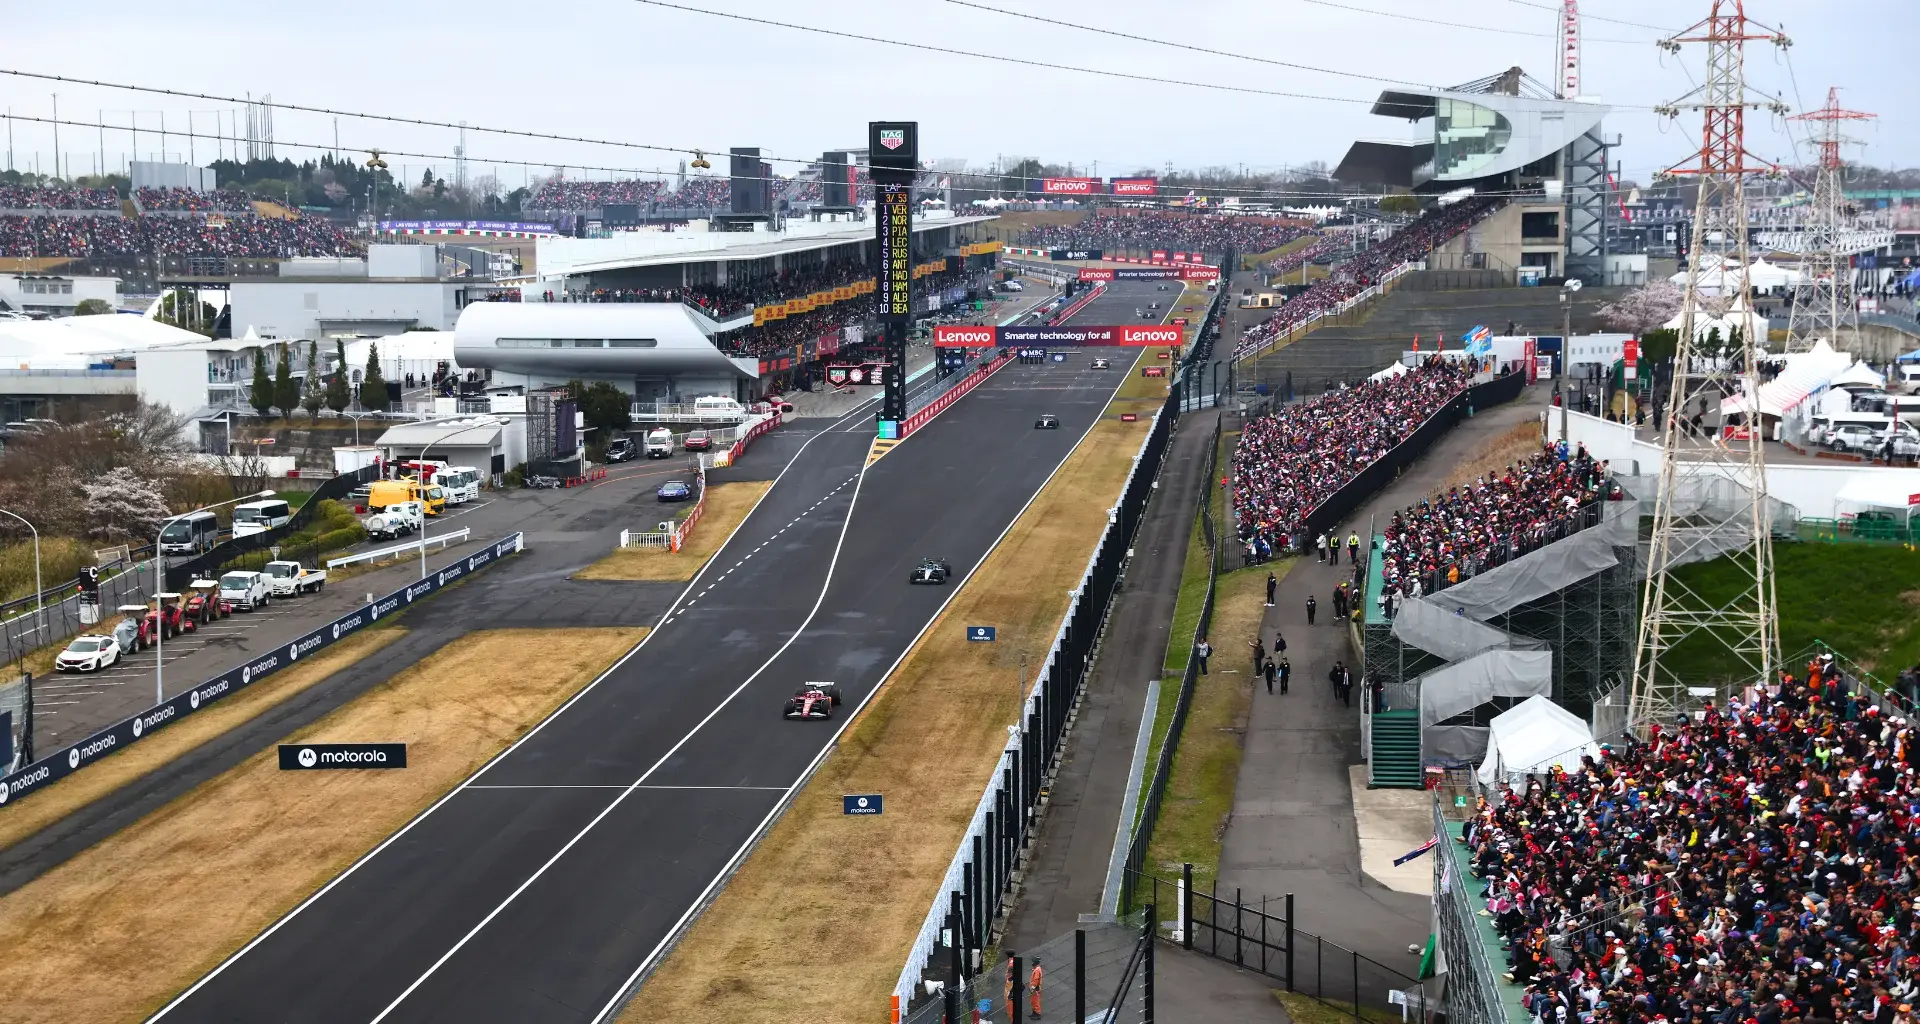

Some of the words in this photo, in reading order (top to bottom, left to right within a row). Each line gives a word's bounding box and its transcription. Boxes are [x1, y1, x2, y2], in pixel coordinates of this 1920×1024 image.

[884, 183, 901, 191] LAP
[1047, 181, 1087, 191] Lenovo
[898, 194, 907, 203] 53
[883, 205, 888, 214] 1
[892, 205, 908, 214] VER
[882, 216, 888, 225] 2
[892, 216, 908, 225] NOR
[882, 227, 888, 236] 3
[892, 227, 908, 236] PIA
[882, 238, 888, 247] 4
[892, 238, 908, 247] LEC
[882, 248, 888, 258] 5
[892, 248, 908, 258] RUS
[882, 259, 888, 269] 6
[892, 260, 908, 269] ANT
[882, 271, 888, 280] 7
[892, 271, 908, 280] HAD
[1186, 270, 1217, 278] Lenovo
[882, 281, 888, 291] 8
[892, 281, 908, 291] HAM
[883, 292, 888, 302] 9
[892, 292, 908, 302] ALB
[880, 303, 888, 313] 10
[892, 303, 908, 313] BEA
[938, 330, 991, 342] Lenovo
[1005, 332, 1038, 340] Smarter
[1040, 331, 1086, 341] technology
[1088, 331, 1100, 339] for
[1101, 331, 1111, 339] all
[1125, 330, 1178, 341] Lenovo
[412, 581, 431, 596] motorola
[378, 598, 398, 614] motorola
[340, 615, 362, 632] motorola
[298, 635, 321, 653] motorola
[251, 656, 277, 676] motorola
[200, 680, 229, 701] motorola
[143, 706, 175, 728] motorola
[81, 735, 116, 759] motorola
[321, 750, 387, 763] motorola
[10, 766, 49, 794] motorola
